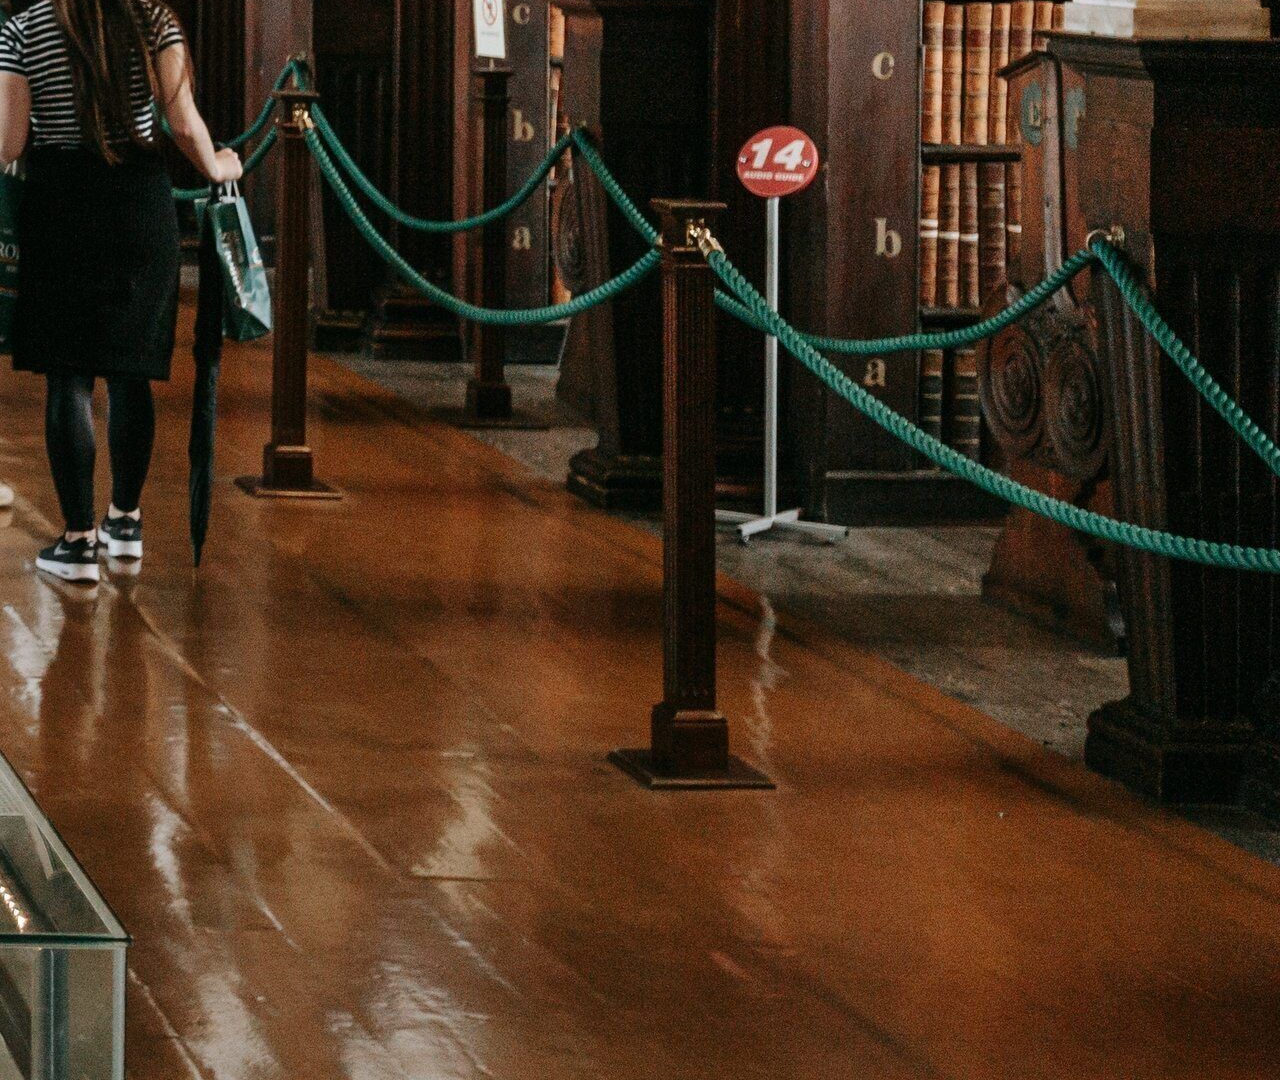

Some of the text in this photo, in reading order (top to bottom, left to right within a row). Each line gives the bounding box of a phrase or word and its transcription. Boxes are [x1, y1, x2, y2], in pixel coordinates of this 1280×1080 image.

[513, 5, 530, 24] c
[872, 52, 894, 79] c
[514, 110, 534, 140] b
[751, 138, 806, 170] 14
[743, 170, 805, 183] AUDIO GUIDE
[876, 218, 901, 256] b
